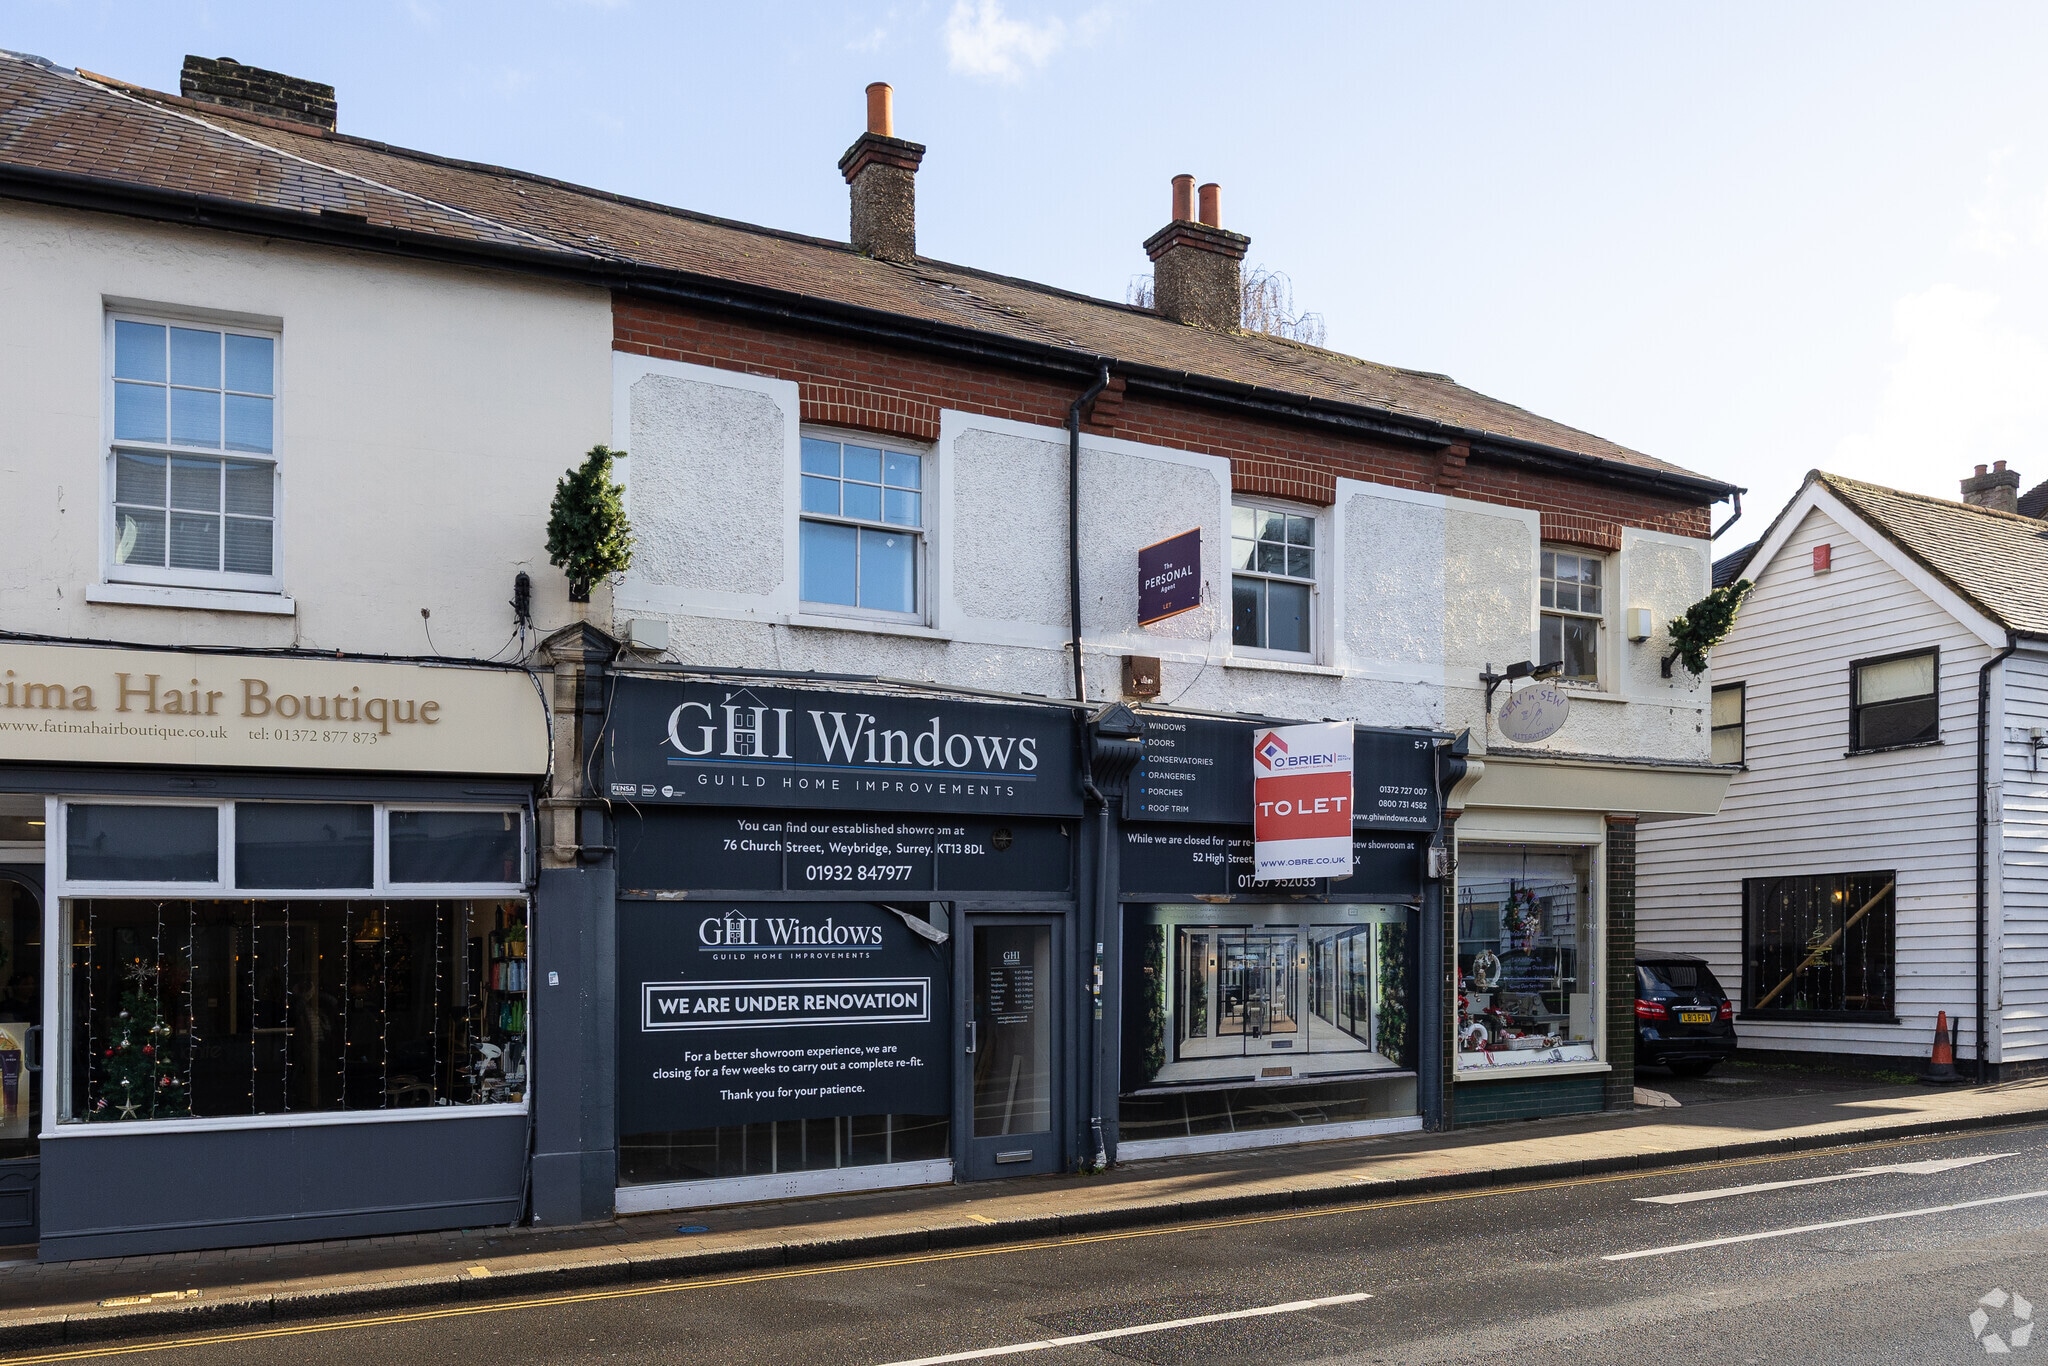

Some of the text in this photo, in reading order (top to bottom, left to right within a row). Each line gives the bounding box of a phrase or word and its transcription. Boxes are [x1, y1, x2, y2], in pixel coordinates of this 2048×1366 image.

[1145, 565, 1192, 590] PERSONAL
[1160, 583, 1176, 594] Agent
[115, 672, 223, 716] Hair
[240, 678, 440, 736] Boutique
[1501, 694, 1523, 719] SEW
[1540, 690, 1565, 707] SEW
[1148, 722, 1186, 732] WINDOWS
[249, 727, 269, 740] tel:
[274, 728, 318, 742] 01372
[322, 730, 348, 744] 877
[352, 732, 378, 744] 873
[667, 701, 1038, 771] GHI Windows
[1148, 739, 1175, 747] DOORS
[1414, 741, 1428, 749] 5-7
[1148, 755, 1214, 766] CONSERVATORIES
[1274, 754, 1333, 767] O'BRIEN
[1148, 772, 1196, 781] ORANGERIES
[698, 774, 1014, 796] GUILD HOME IMPROVEMENTS
[1379, 786, 1427, 796] 01372 727 007
[1148, 788, 1183, 796] PORCHES
[1172, 805, 1189, 813] TRIM
[1258, 796, 1348, 817] TO LET
[1378, 800, 1427, 810] 0800 731 4582
[738, 820, 759, 831] You
[762, 823, 782, 831] can
[786, 821, 807, 833] find
[810, 825, 830, 833] our
[832, 823, 894, 834] established
[954, 827, 965, 835] at
[1127, 833, 1152, 843] While
[1184, 835, 1210, 845] closed
[1212, 836, 1224, 845] for
[1368, 840, 1406, 849] showroom
[724, 840, 985, 856] 76 Church Street, Weybridge, Surrey. KT13 8DL
[1192, 853, 1203, 862] 52
[1206, 853, 1224, 865] High
[1261, 856, 1346, 867] WWW.OBRE.CO.UK
[806, 865, 912, 880] 01932 847977
[699, 917, 882, 945] GHI Windows
[1003, 951, 1020, 960] GHI
[658, 992, 918, 1014] WE ARE UNDER RENOVATION
[685, 1051, 703, 1062] For
[714, 1050, 748, 1060] better
[750, 1048, 804, 1059] showroom
[806, 1046, 864, 1058] experience,
[882, 1045, 898, 1053] are
[653, 1068, 692, 1080] closing
[694, 1066, 710, 1077] for
[721, 1065, 741, 1076] few
[743, 1063, 776, 1075] weeks
[778, 1064, 789, 1073] to
[792, 1064, 818, 1074] carry
[820, 1062, 838, 1070] out
[840, 1062, 846, 1070] a
[848, 1058, 894, 1071] complete
[896, 1056, 924, 1067] re-fit.
[720, 1084, 865, 1101] Thank you for your patience.
